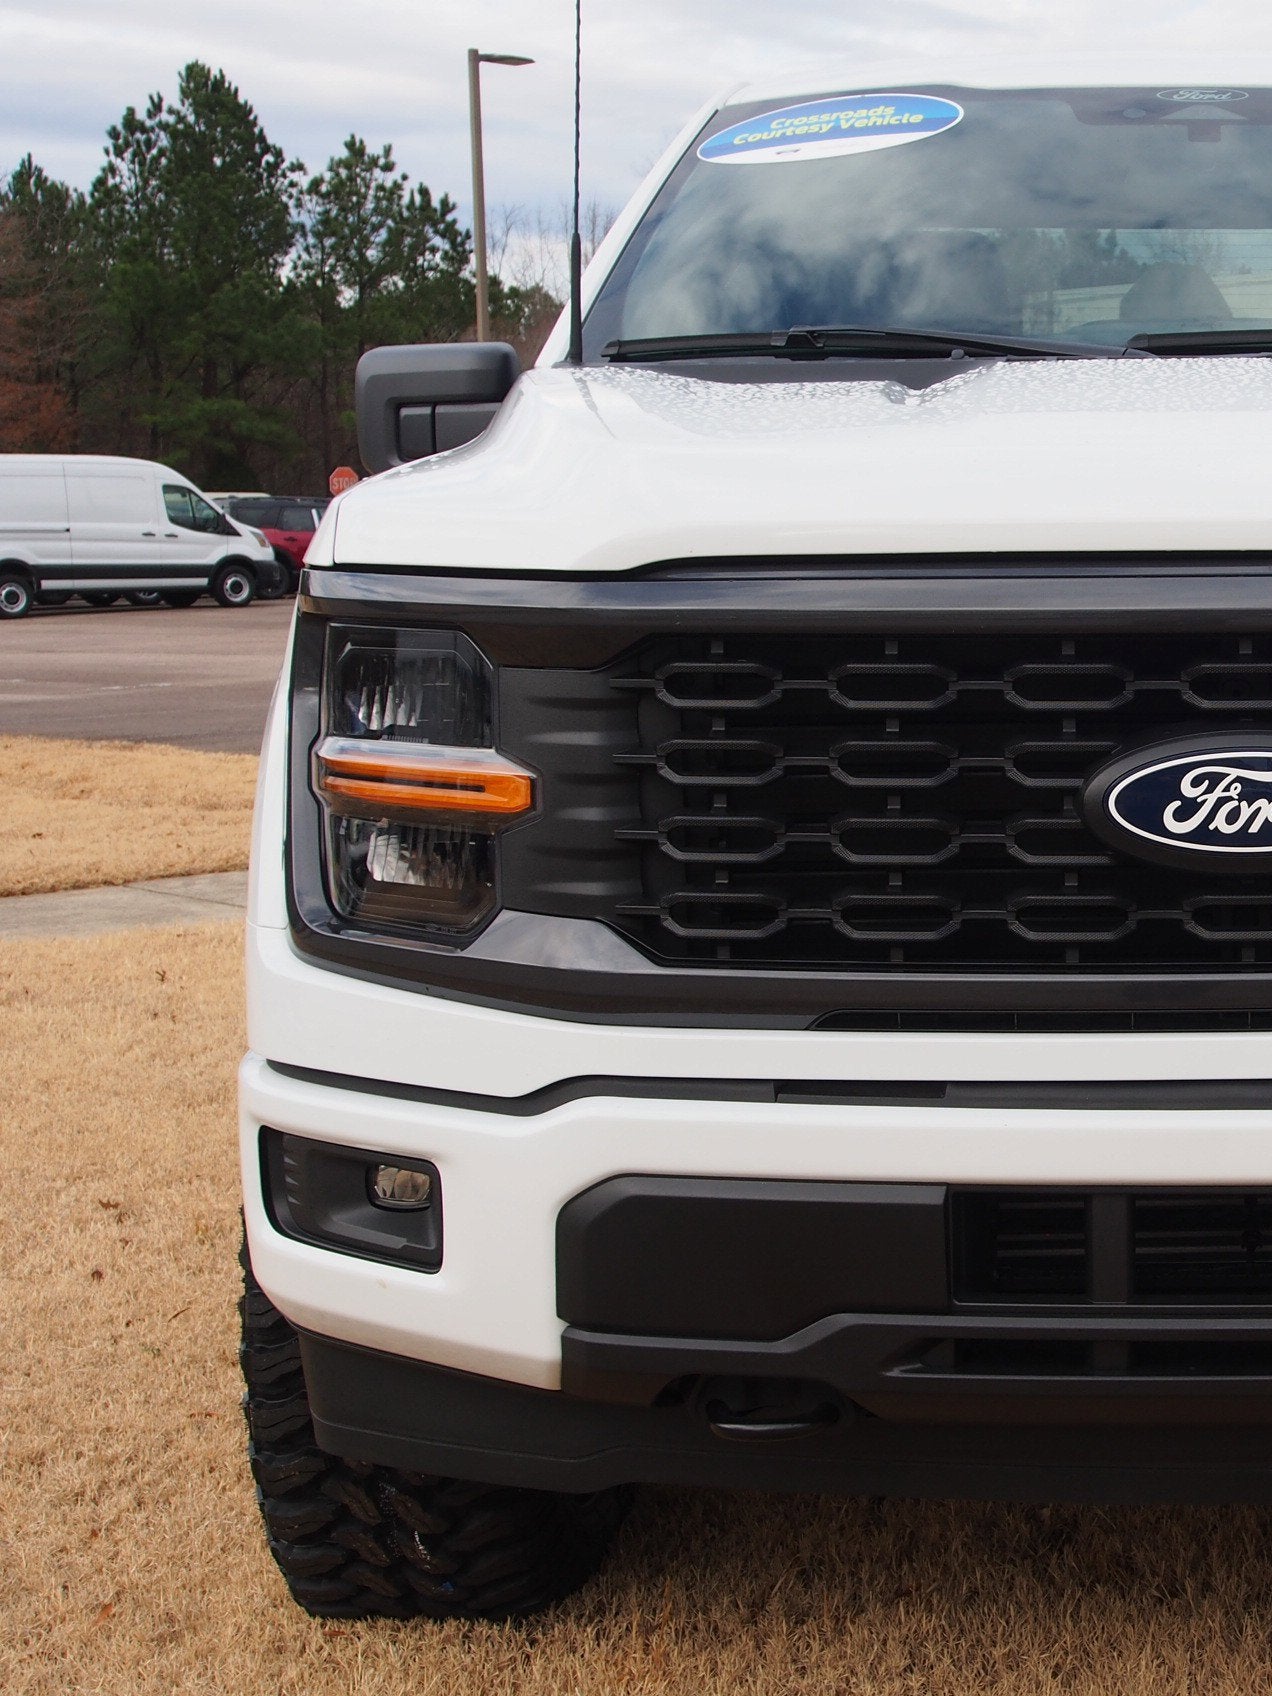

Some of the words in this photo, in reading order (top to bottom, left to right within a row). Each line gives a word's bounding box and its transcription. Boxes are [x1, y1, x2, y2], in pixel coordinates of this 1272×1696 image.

[1172, 89, 1233, 100] Ford
[733, 121, 836, 145] Courtesy
[839, 112, 924, 130] Vehicle
[770, 105, 896, 130] Crossroads
